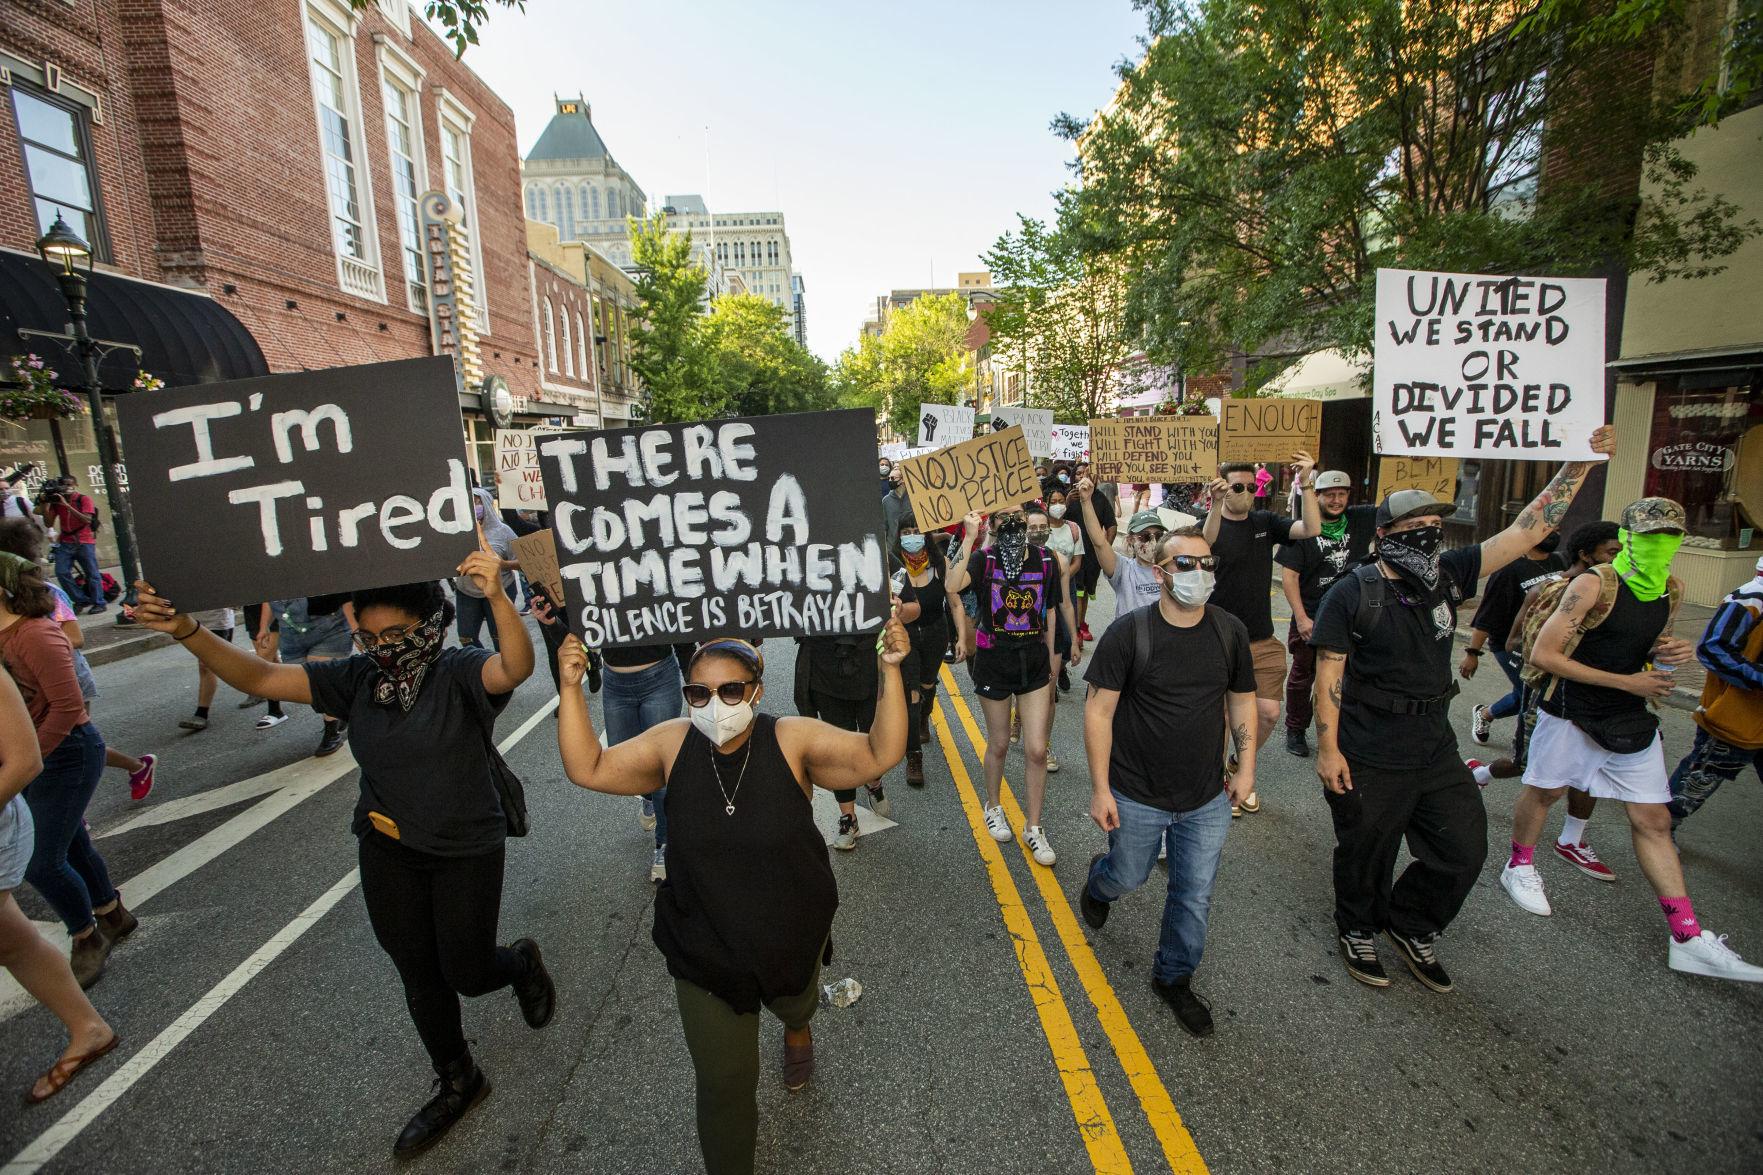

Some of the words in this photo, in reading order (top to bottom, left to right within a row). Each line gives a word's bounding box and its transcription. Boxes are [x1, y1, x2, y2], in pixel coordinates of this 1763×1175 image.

[1407, 276, 1566, 317] UNITED
[1389, 318, 1442, 346] WE
[1454, 315, 1569, 346] STAND
[1461, 350, 1520, 382] OR
[1392, 381, 1572, 416] DIVIDED
[153, 392, 352, 481] I'm
[502, 434, 523, 448] NO
[1059, 428, 1089, 440] Togeth
[1095, 427, 1116, 438] WILL
[1124, 425, 1161, 438] STAND
[1167, 427, 1195, 438] WITH
[1200, 427, 1218, 439] YOU
[1095, 438, 1120, 450] WILL
[1124, 438, 1162, 450] FIGHT
[1168, 439, 1197, 450] WITH
[1199, 439, 1218, 451] YOU
[1397, 416, 1456, 448] WE
[1474, 418, 1562, 449] FALL
[501, 452, 520, 469] NO
[540, 423, 758, 493] THERE
[904, 456, 947, 494] NO
[940, 435, 1029, 490] JUSTICE
[1096, 462, 1123, 474] HEAR
[1149, 463, 1168, 474] SEE
[1171, 464, 1189, 475] YOU
[1097, 451, 1119, 462] WILL
[1123, 451, 1168, 462] DEFEND
[1173, 451, 1192, 461] YOU
[1396, 457, 1442, 481] BLM
[1663, 455, 1723, 467] YARNS
[229, 459, 473, 557] Tired
[919, 494, 953, 528] NO
[960, 463, 1033, 511] PEACE
[554, 490, 751, 554] COMES
[765, 472, 810, 546] A
[520, 538, 545, 560] NO
[560, 547, 706, 604] TIME
[710, 533, 883, 594] WHEN
[582, 601, 693, 648] SILENCE
[701, 596, 727, 629] IS
[738, 590, 882, 636] BETRAYAL
